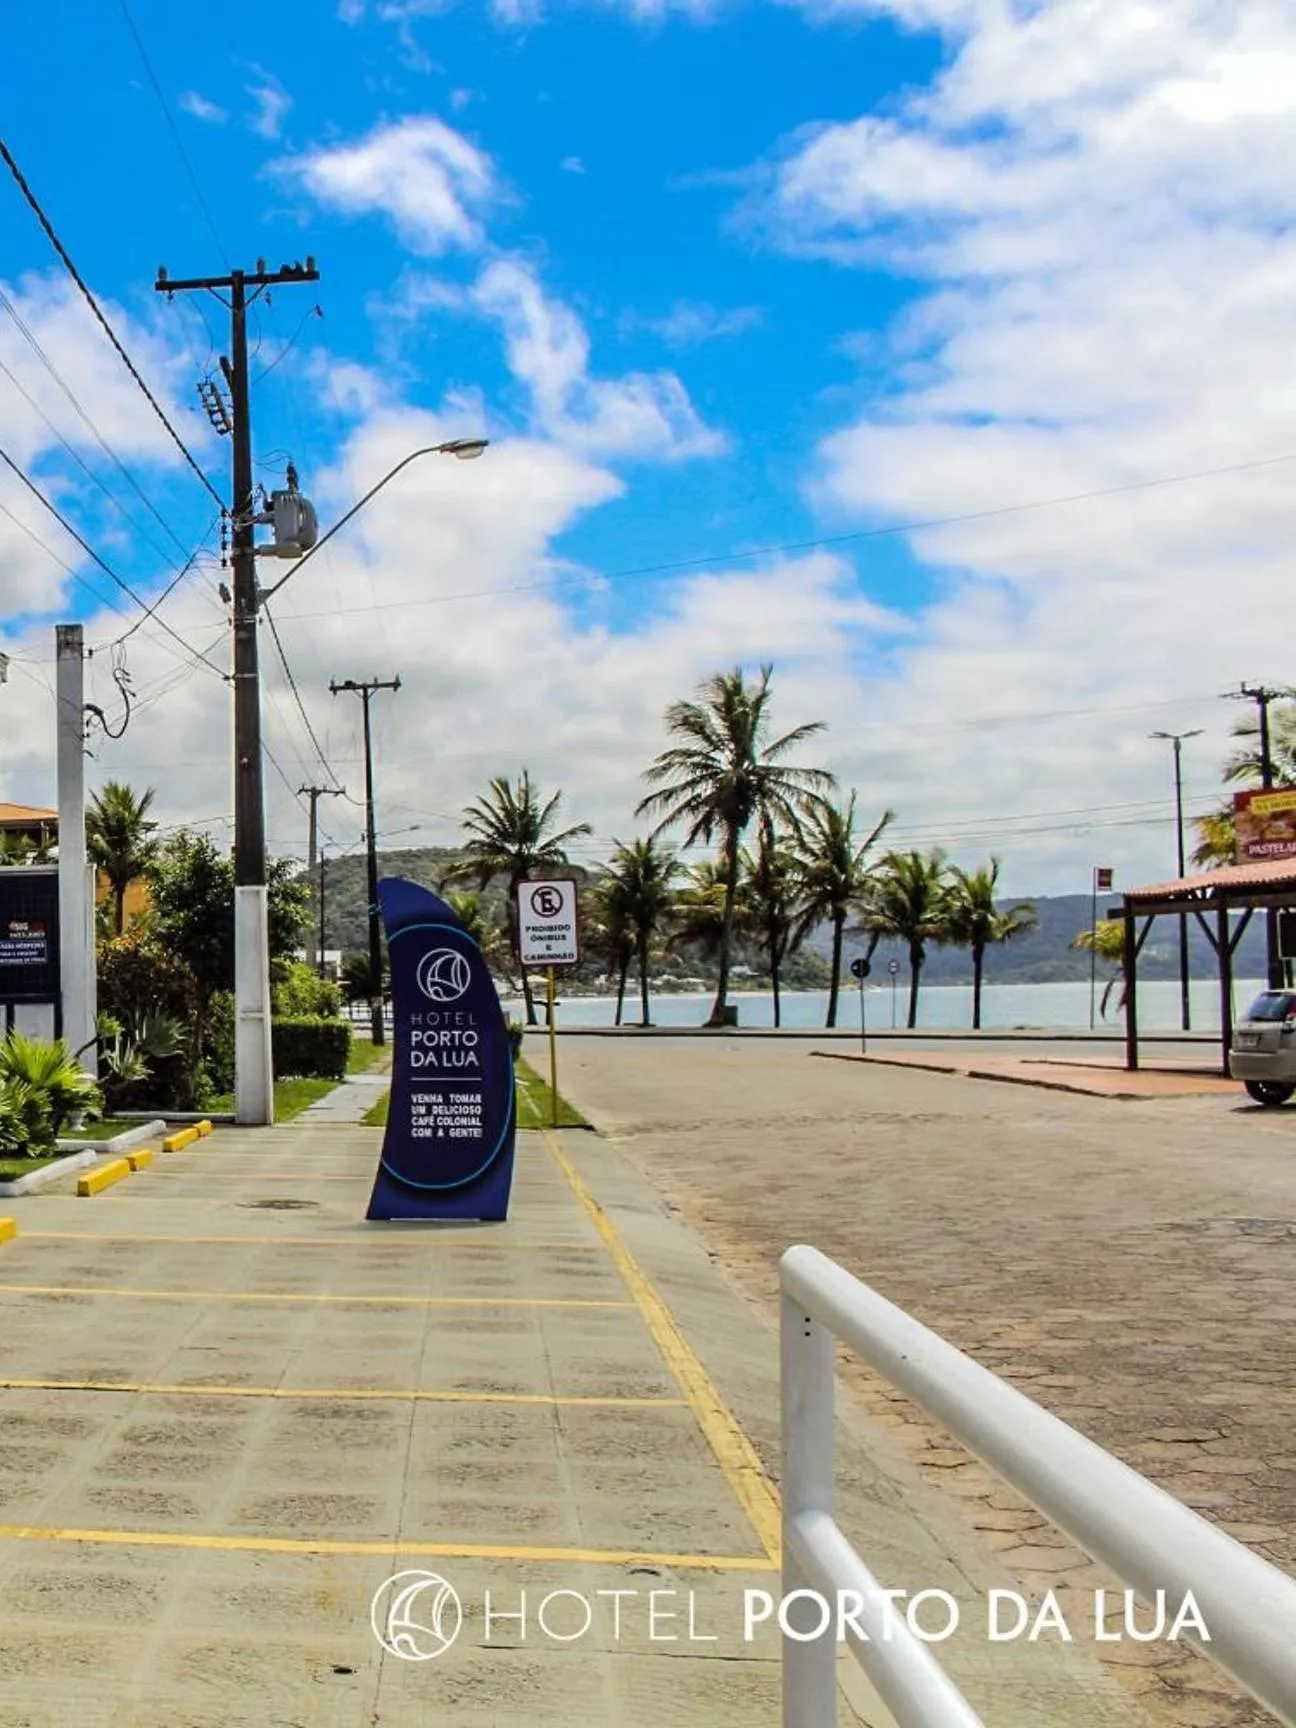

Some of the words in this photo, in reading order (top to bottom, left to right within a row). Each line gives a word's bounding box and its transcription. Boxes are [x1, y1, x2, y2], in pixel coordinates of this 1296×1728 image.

[525, 924, 571, 932] PROIBIDO
[411, 1012, 478, 1025] HOTEL
[411, 1030, 478, 1047] PORTO
[411, 1050, 438, 1067] DA
[443, 1050, 479, 1067] LUA
[411, 1093, 443, 1103] VENHA
[449, 1093, 481, 1103] TOMAR
[411, 1105, 426, 1115] UM
[432, 1105, 482, 1115] DELICIOSO
[411, 1115, 434, 1126] CAFÉ
[437, 1116, 482, 1126] COLONIAL
[411, 1127, 432, 1137] COM
[437, 1128, 444, 1137] A
